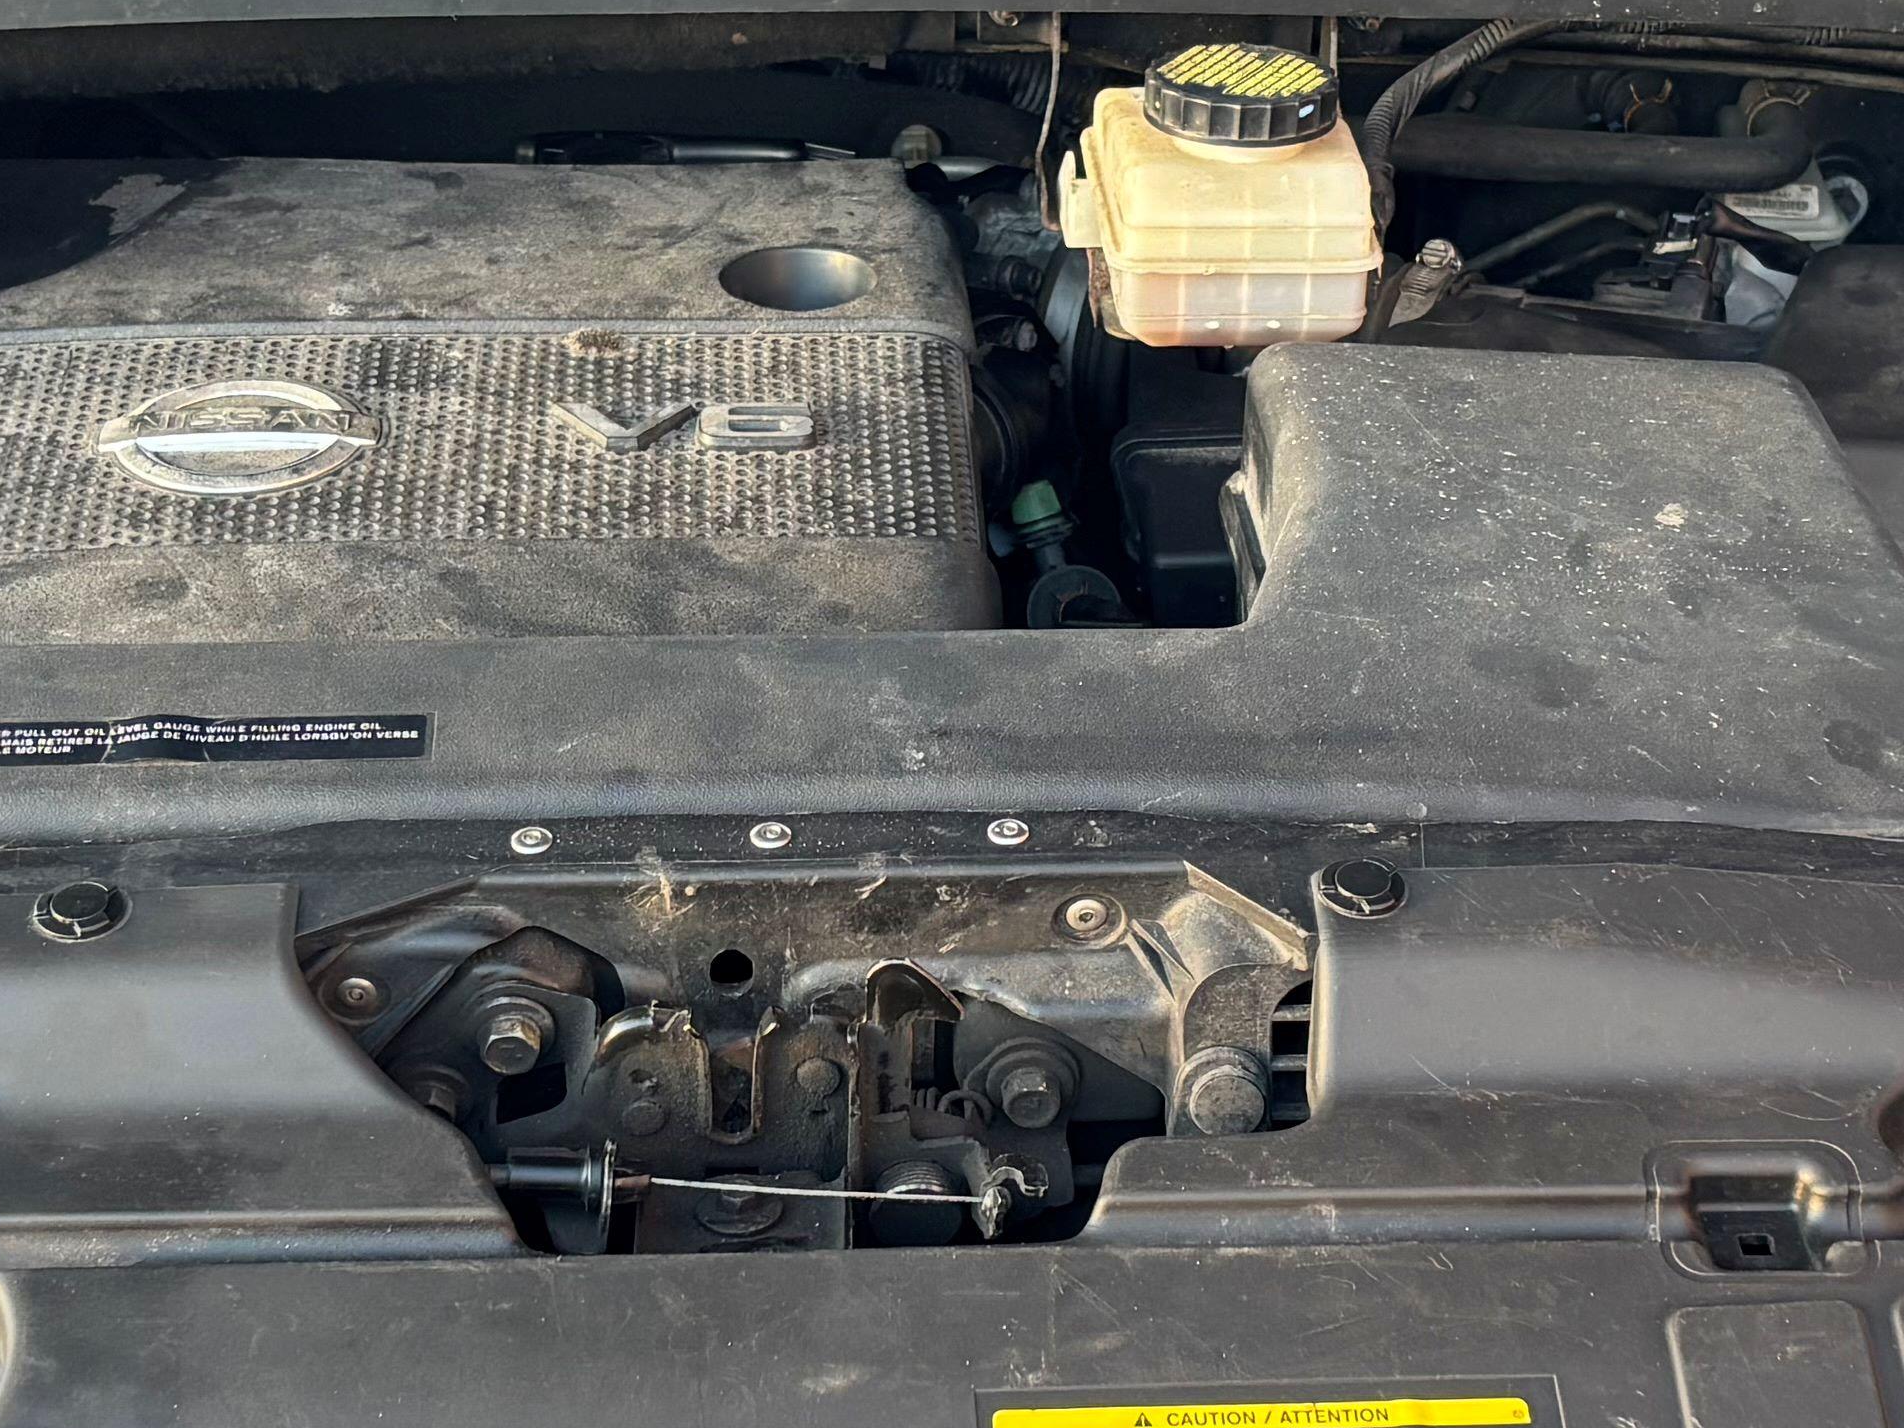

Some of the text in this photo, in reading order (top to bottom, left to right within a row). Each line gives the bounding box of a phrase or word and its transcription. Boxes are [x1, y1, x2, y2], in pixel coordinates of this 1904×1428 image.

[130, 399, 818, 453] NISSAN V6
[14, 729, 46, 737] PULL
[52, 728, 80, 737] OUT
[86, 728, 106, 736] OIL
[110, 723, 148, 735] LEVEL
[153, 721, 201, 732] GAUGE
[206, 725, 246, 733] WHILE
[251, 724, 301, 732] FILLING
[306, 723, 356, 732] ENGINE
[37, 737, 93, 746] RETIRER
[97, 737, 114, 745] LA
[117, 731, 159, 744] JAUGE
[163, 731, 181, 740] DE
[185, 733, 235, 743] NIVEAU
[376, 730, 419, 739] VERSE
[1167, 1410, 1255, 1426] CAUTION
[1280, 1408, 1389, 1424] ATTENTION
